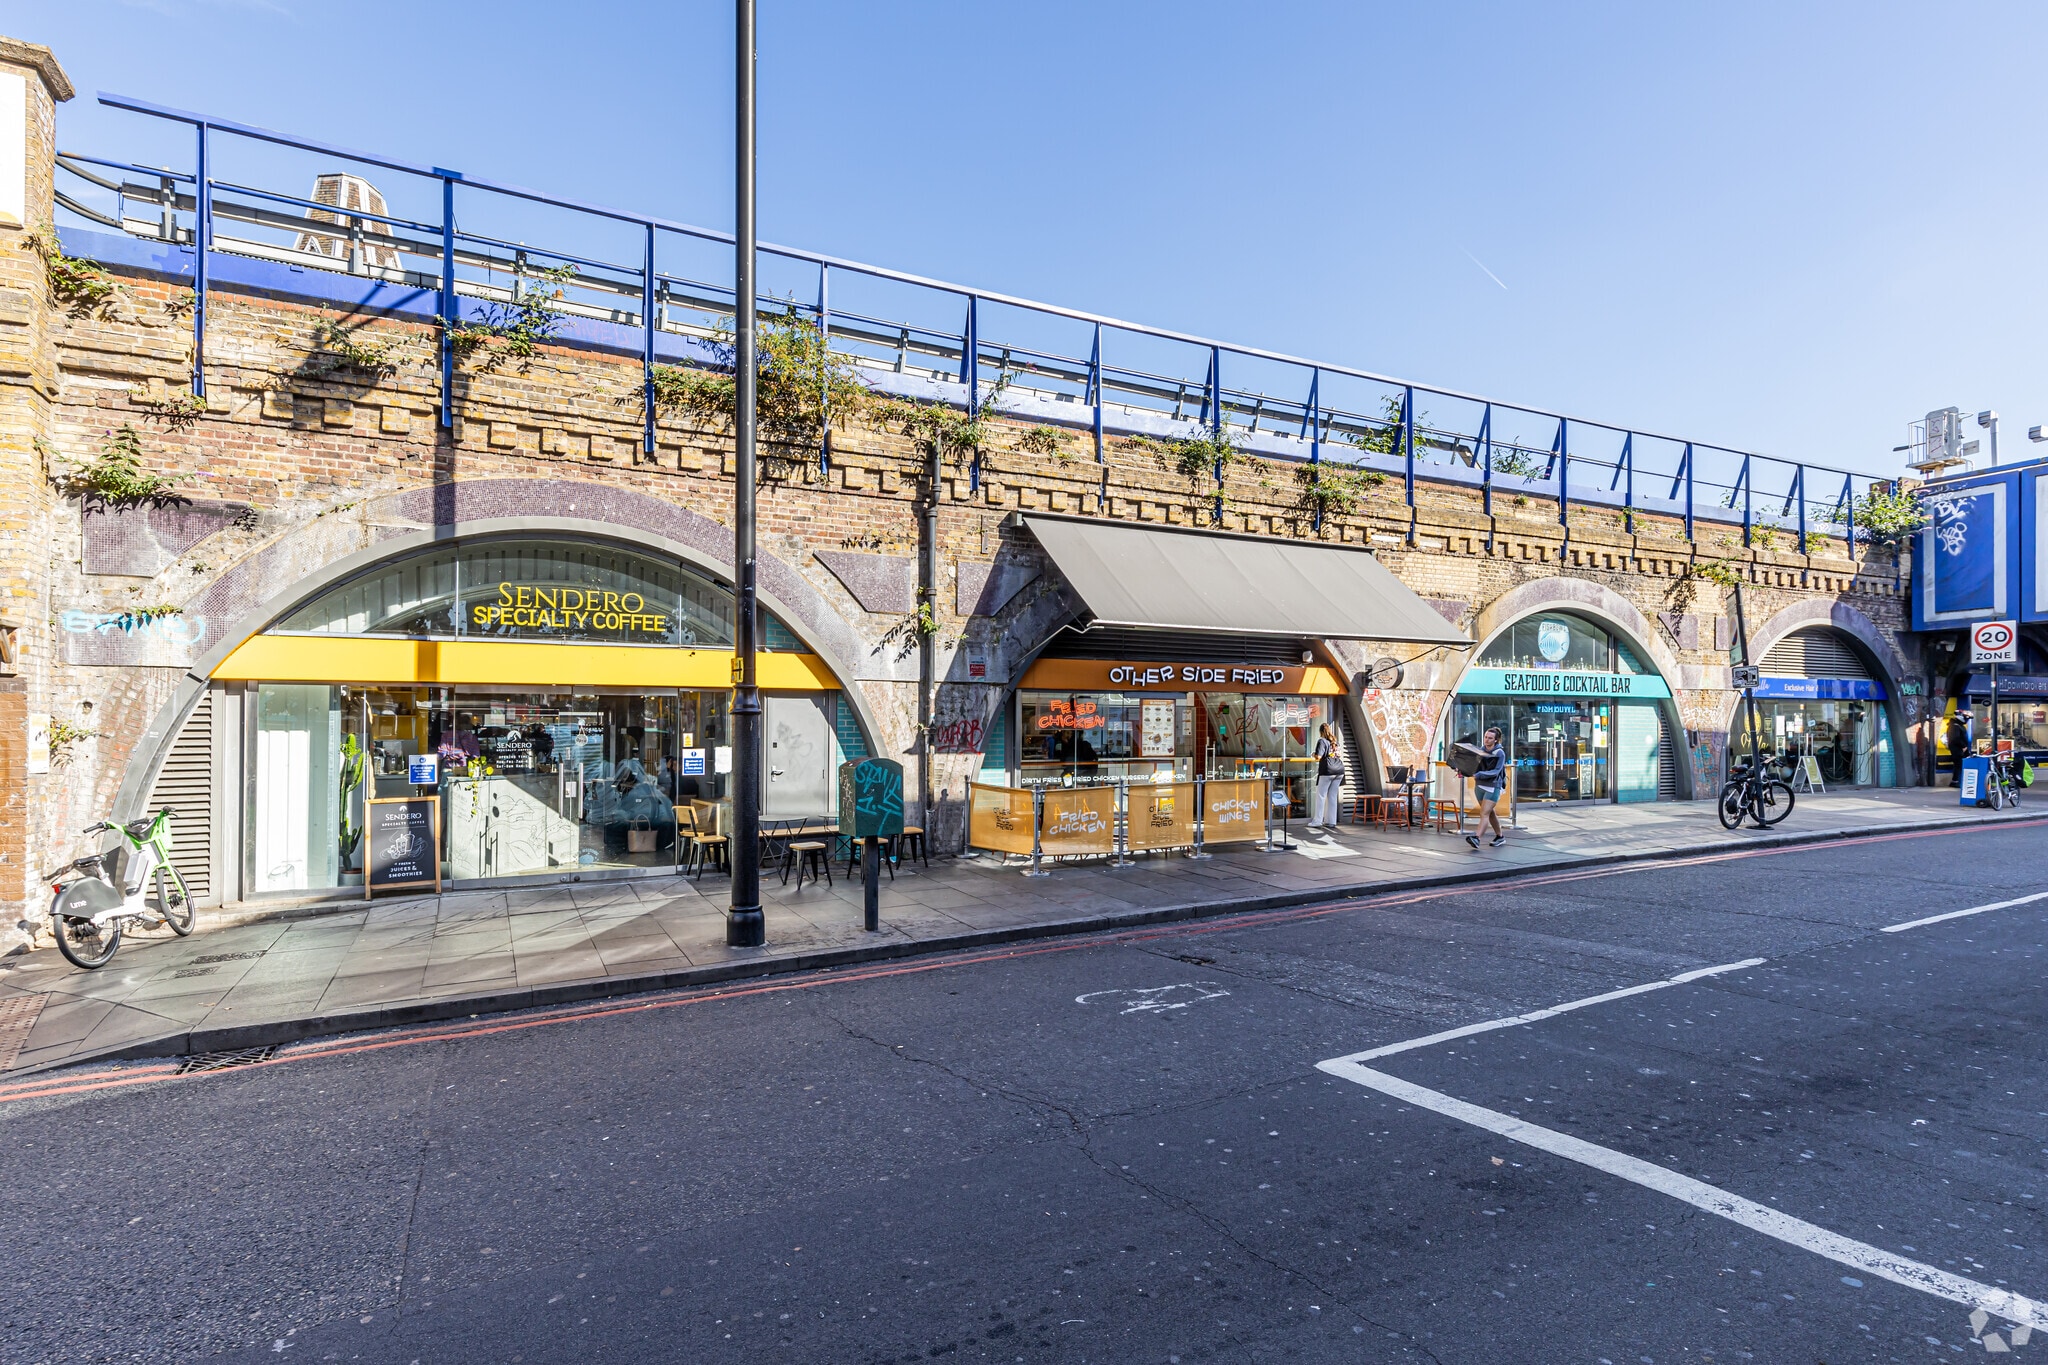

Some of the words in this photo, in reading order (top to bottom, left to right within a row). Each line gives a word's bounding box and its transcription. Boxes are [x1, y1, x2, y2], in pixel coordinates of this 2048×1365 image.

[498, 582, 645, 614] SENDERO
[473, 606, 589, 628] SPECIALTY
[592, 611, 666, 632] COFFEE
[1981, 631, 2008, 643] 20
[1976, 652, 2011, 660] ZONE
[1109, 665, 1175, 687] OTHER
[1504, 673, 1551, 691] SEAFOOD
[1553, 675, 1560, 692] &
[1563, 675, 1609, 693] COCKTAIL
[1611, 677, 1631, 693] BAR
[1212, 799, 1258, 812] CHICKEN
[385, 813, 422, 821] SENDERO
[1060, 810, 1099, 823] FRIED
[1049, 820, 1106, 835] CHICKEN
[1151, 819, 1174, 828] FRIED
